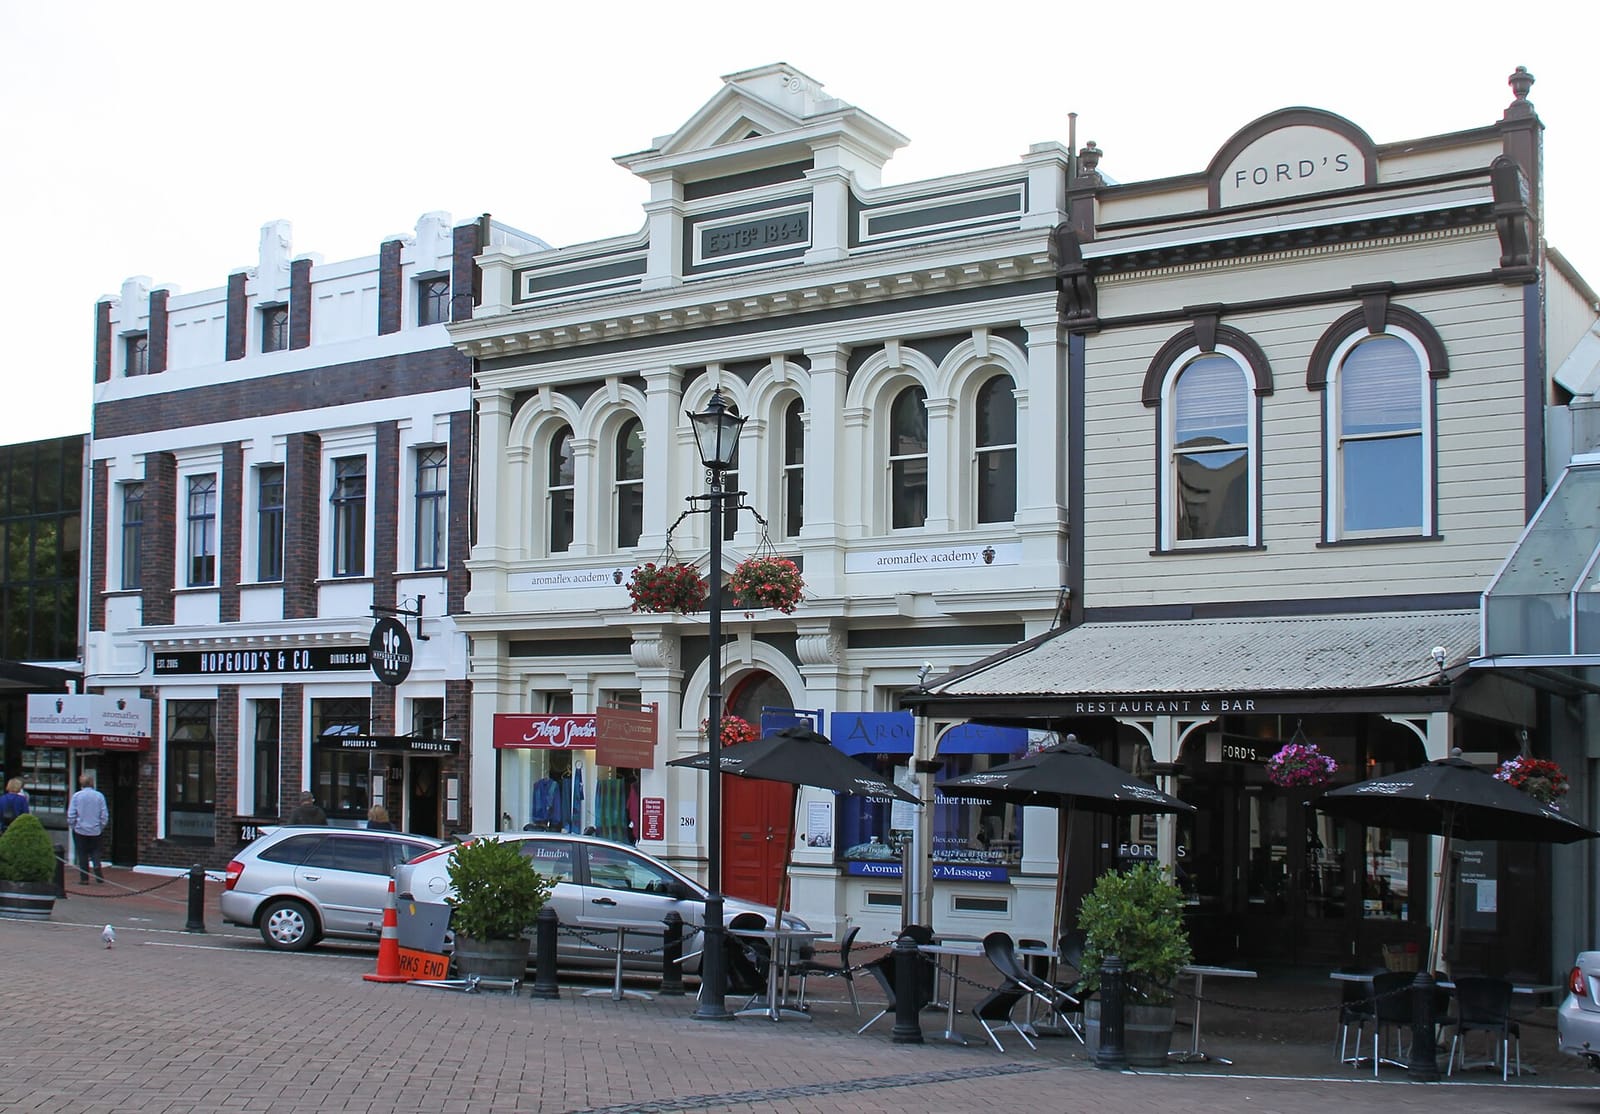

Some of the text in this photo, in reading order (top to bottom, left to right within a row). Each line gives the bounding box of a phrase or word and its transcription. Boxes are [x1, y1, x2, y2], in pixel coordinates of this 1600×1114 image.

[1235, 153, 1349, 189] FORD'S
[763, 219, 804, 243] 1864
[877, 550, 979, 566] aromaflex academy
[531, 571, 611, 585] aromaflex academy
[201, 650, 314, 672] HOPGOOD'S & CO.
[330, 653, 367, 664] DINING & BAR
[1076, 700, 1256, 713] RESTAURANT & BAR
[102, 711, 140, 720] aromaflex
[103, 719, 137, 731] academy
[1223, 744, 1256, 761] FORD'S
[680, 816, 695, 827] 280
[241, 826, 256, 840] 284
[1120, 844, 1186, 857] FORS
[943, 867, 992, 879] Massage
[423, 959, 444, 978] END
